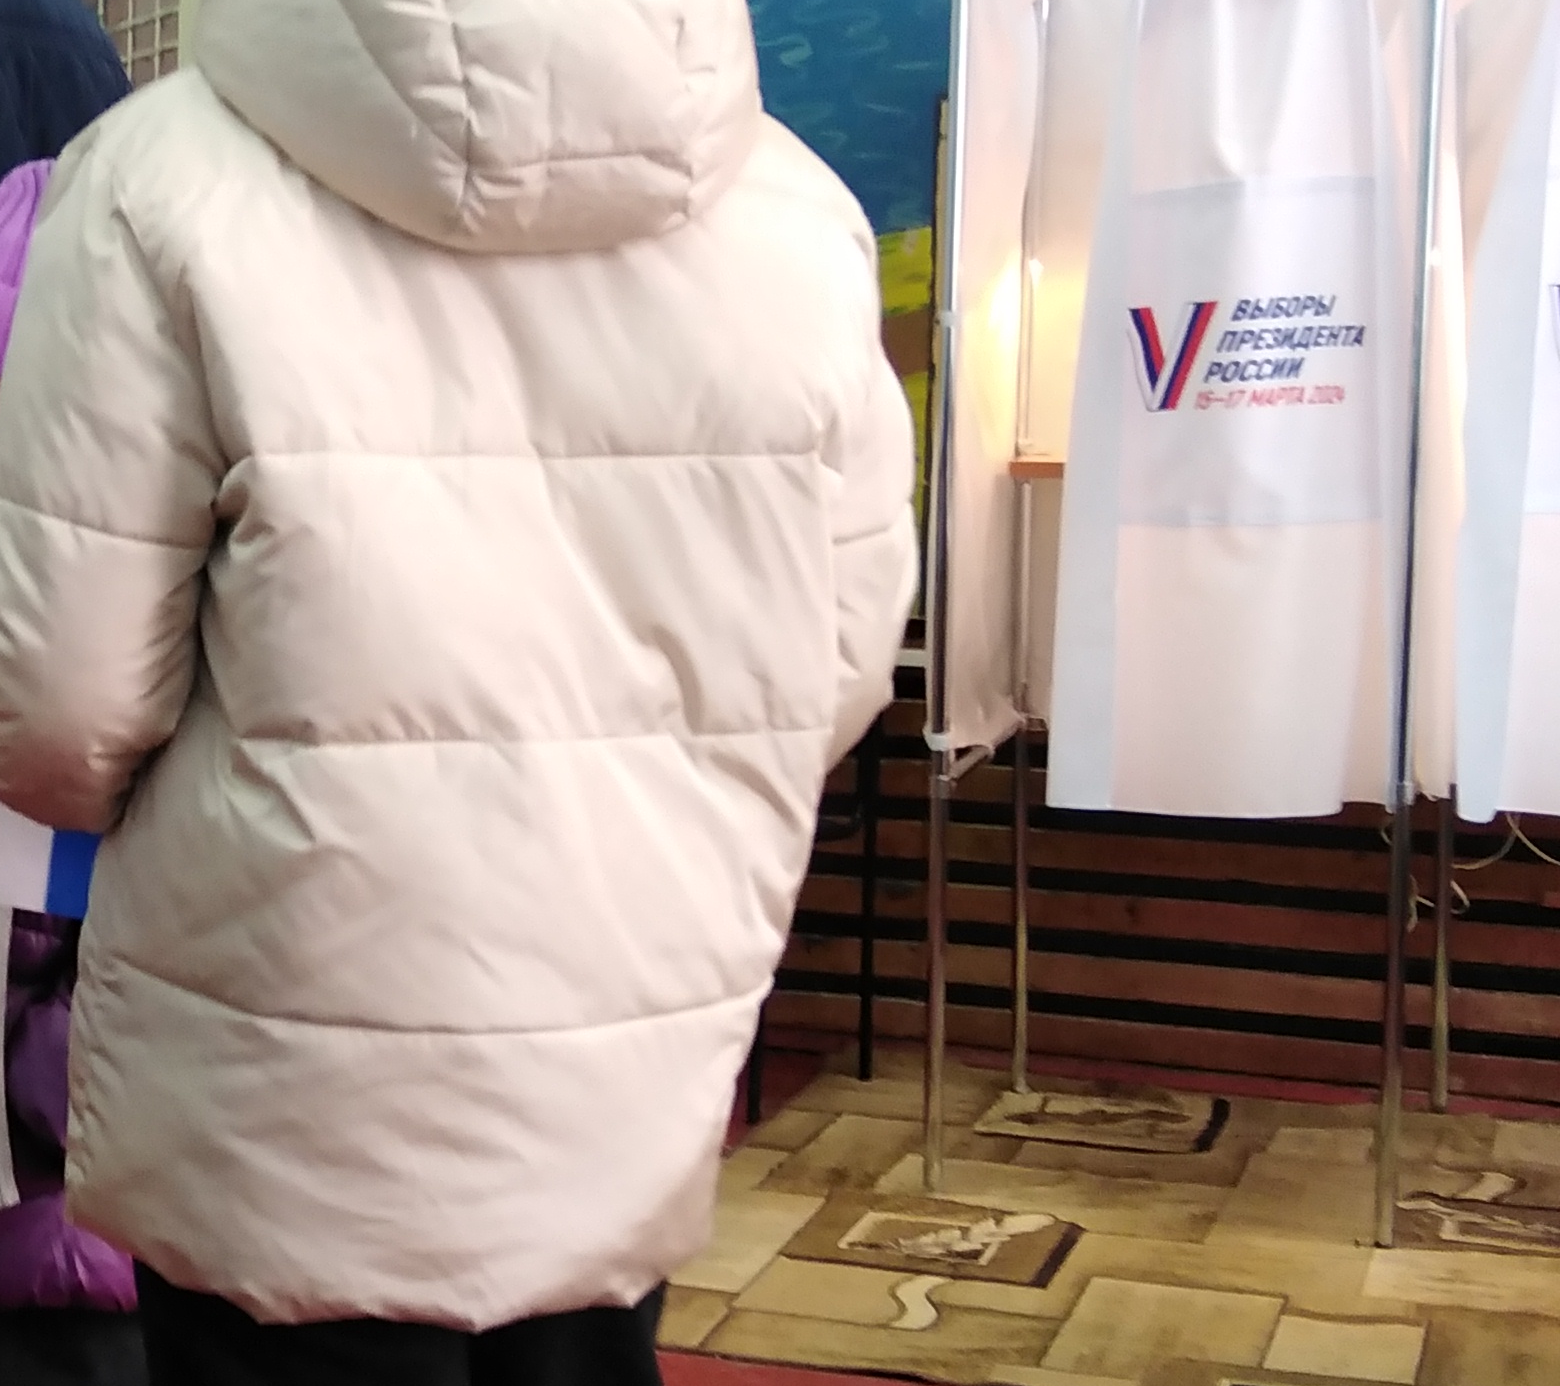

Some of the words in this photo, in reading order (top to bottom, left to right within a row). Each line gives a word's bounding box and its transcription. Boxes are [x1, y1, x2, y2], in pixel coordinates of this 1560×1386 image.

[1230, 295, 1337, 321] ВЫБОРЫ
[1216, 325, 1366, 354] ПРЕЗИДЕНТА
[1203, 357, 1306, 383] РОССИИ
[1247, 386, 1305, 407] МАРТА
